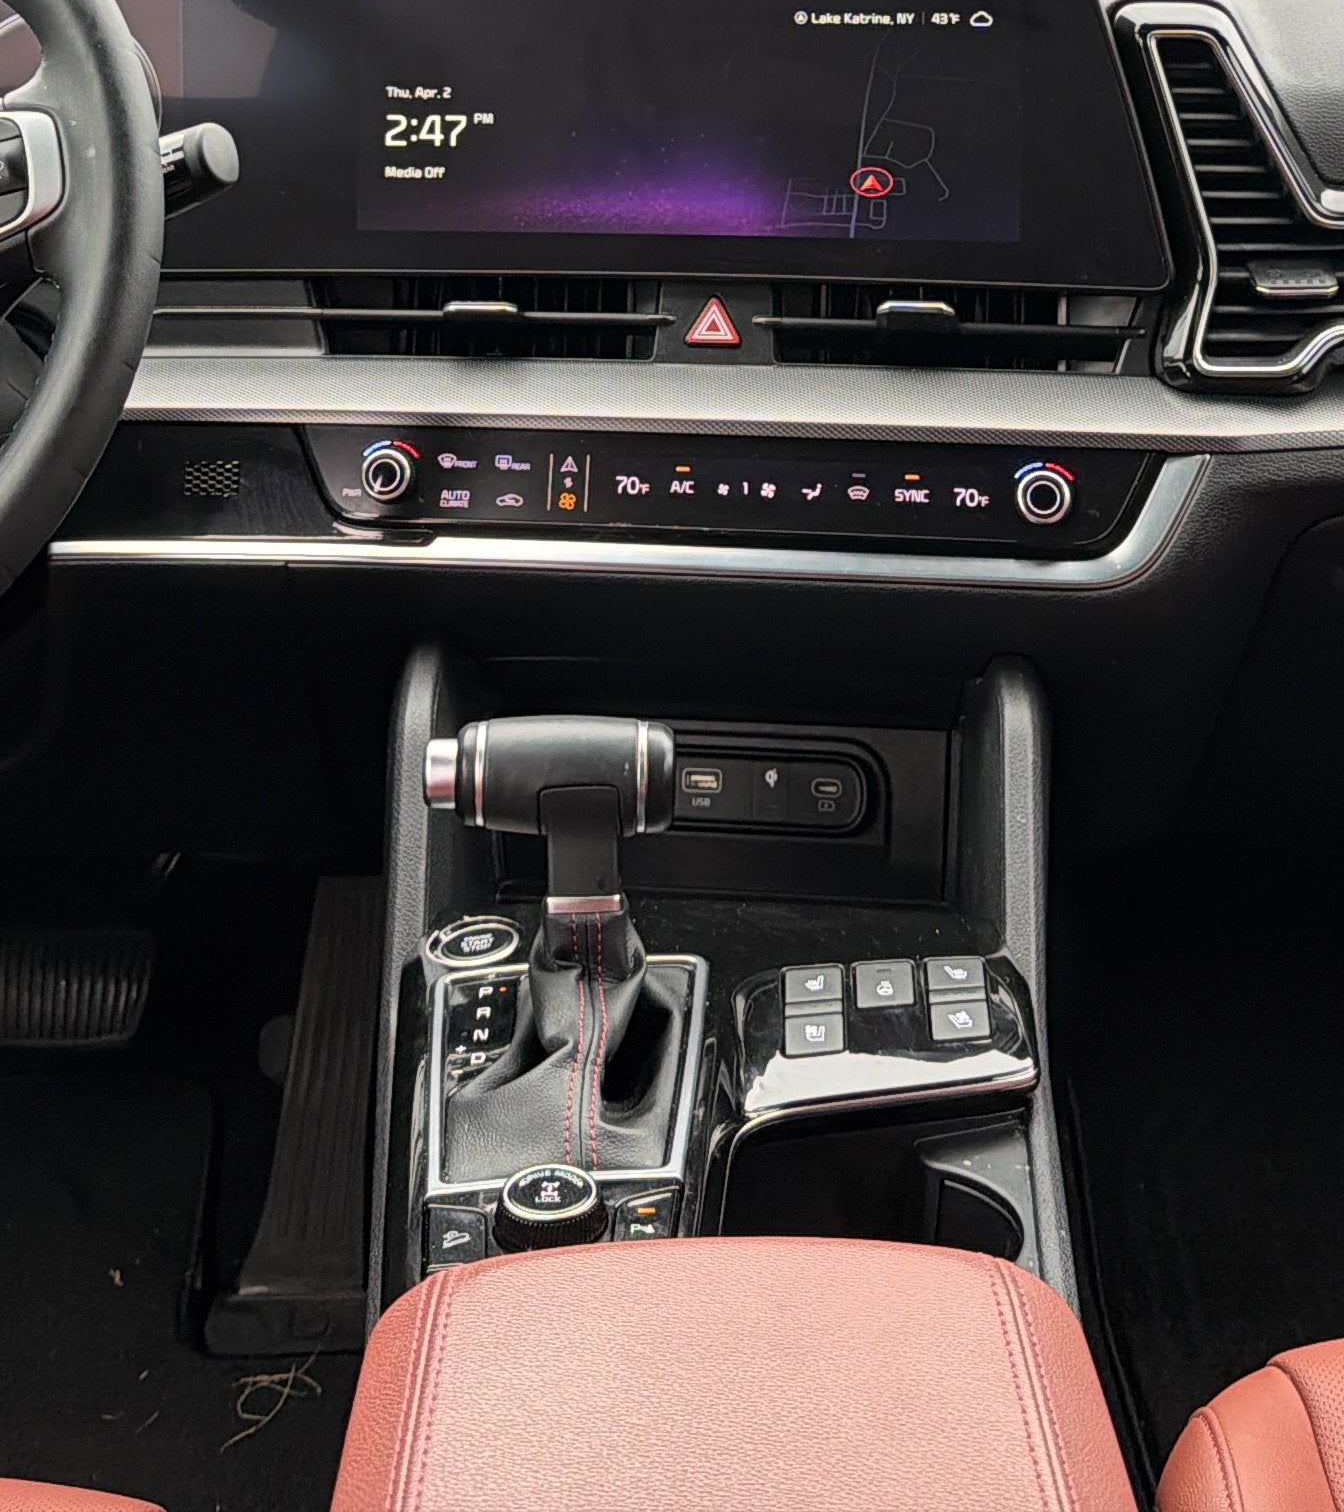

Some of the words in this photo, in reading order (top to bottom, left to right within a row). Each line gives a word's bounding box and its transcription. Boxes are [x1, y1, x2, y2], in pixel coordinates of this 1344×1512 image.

[811, 12, 842, 25] Lake
[843, 12, 895, 26] Katrine,
[896, 12, 916, 25] NY
[931, 12, 961, 25] 43°F
[385, 86, 413, 99] Thu,
[414, 86, 441, 100] Apr.
[442, 86, 452, 99] 2
[384, 114, 468, 147] 2:47
[473, 112, 495, 125] PM
[384, 166, 423, 179] Media
[424, 166, 446, 179] Off
[455, 460, 478, 469] FRONT
[511, 462, 531, 471] REAR
[669, 480, 695, 494] A/C
[742, 481, 749, 495] 1
[440, 489, 471, 500] AUTO
[894, 488, 931, 504] SYNC
[439, 500, 469, 508] CLIMATE
[691, 797, 711, 807] USB
[478, 986, 494, 1000] P
[472, 1027, 490, 1043] N
[470, 1051, 487, 1067] D
[534, 1195, 562, 1203] LOCK
